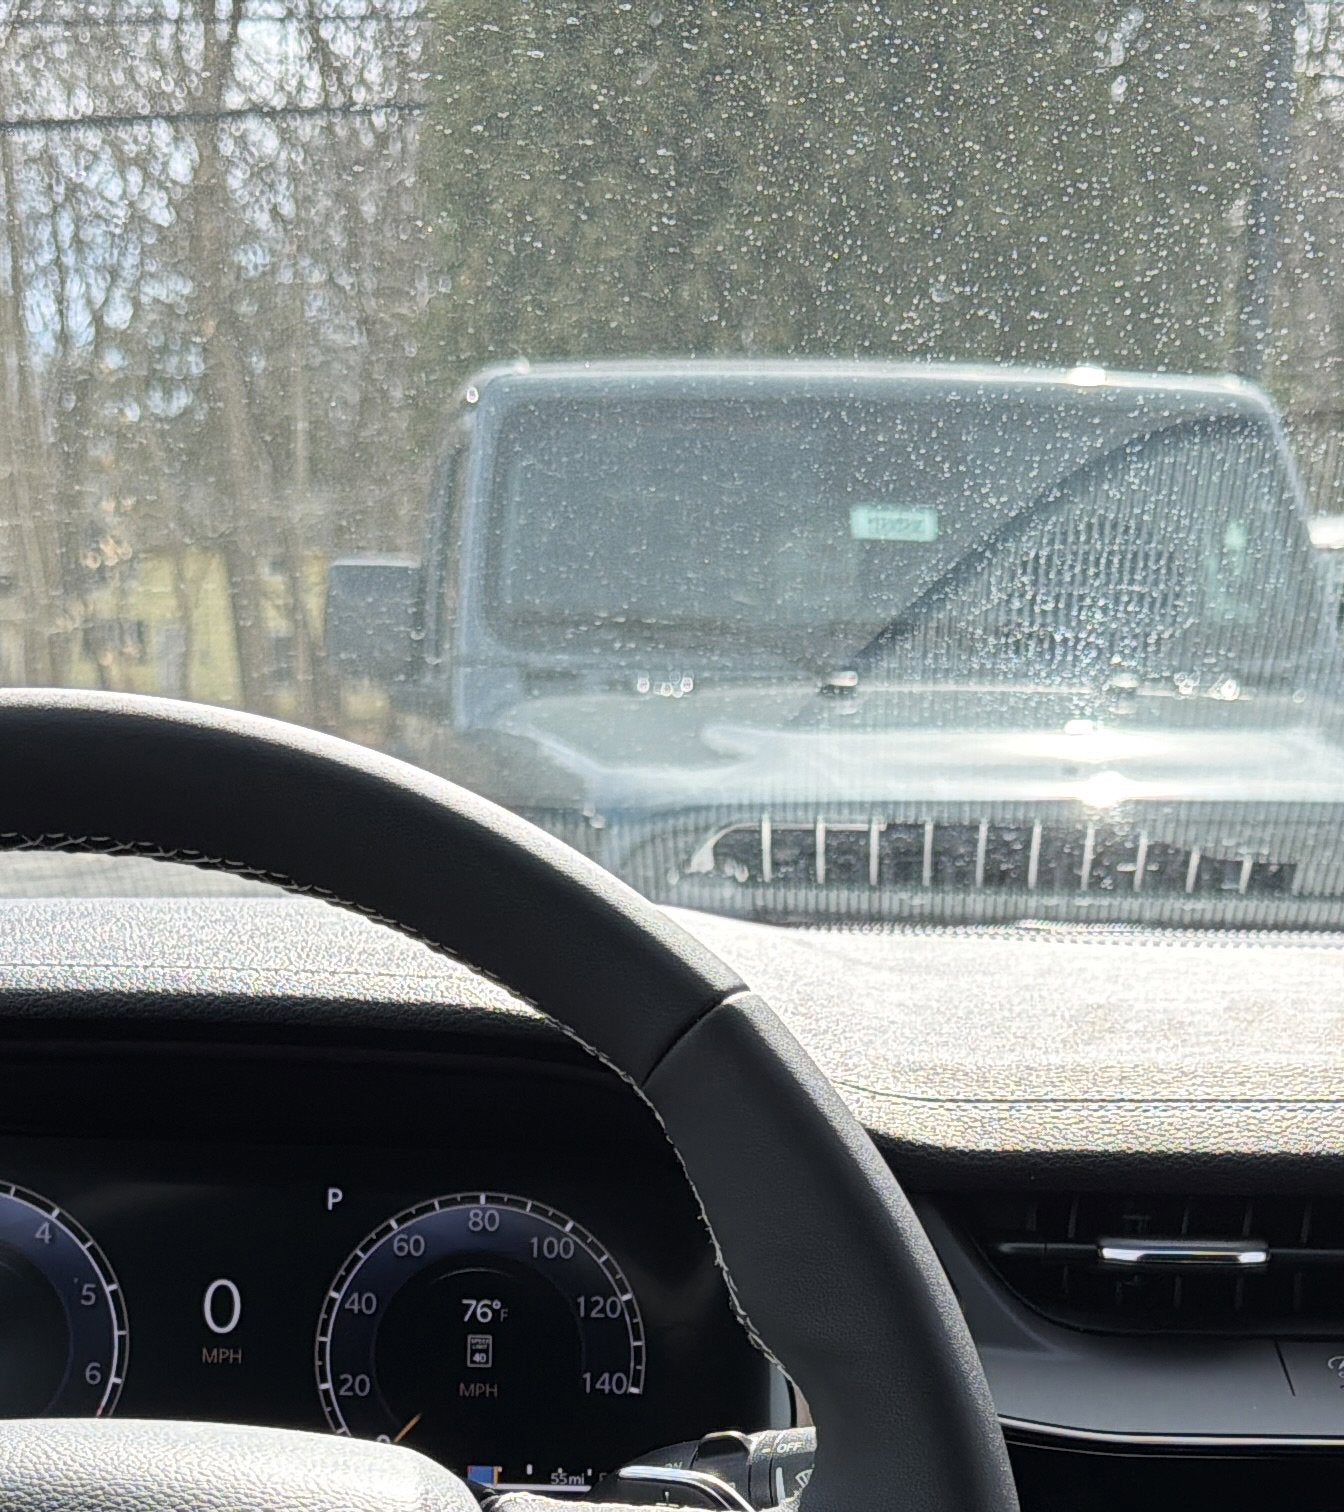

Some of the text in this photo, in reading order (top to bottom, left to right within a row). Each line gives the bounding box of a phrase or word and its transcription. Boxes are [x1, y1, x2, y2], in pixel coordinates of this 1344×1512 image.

[327, 1189, 343, 1211] P
[468, 1210, 500, 1233] 80
[35, 1223, 52, 1244] 4
[393, 1234, 425, 1258] 60
[530, 1236, 575, 1259] 100
[80, 1284, 96, 1306] 5
[345, 1292, 377, 1315] 40
[203, 1279, 241, 1335] 0
[577, 1296, 622, 1319] 120
[202, 1347, 243, 1365] MPH
[85, 1363, 102, 1385] 6
[339, 1374, 371, 1397] 20
[582, 1372, 628, 1396] 140
[459, 1382, 498, 1397] MPH
